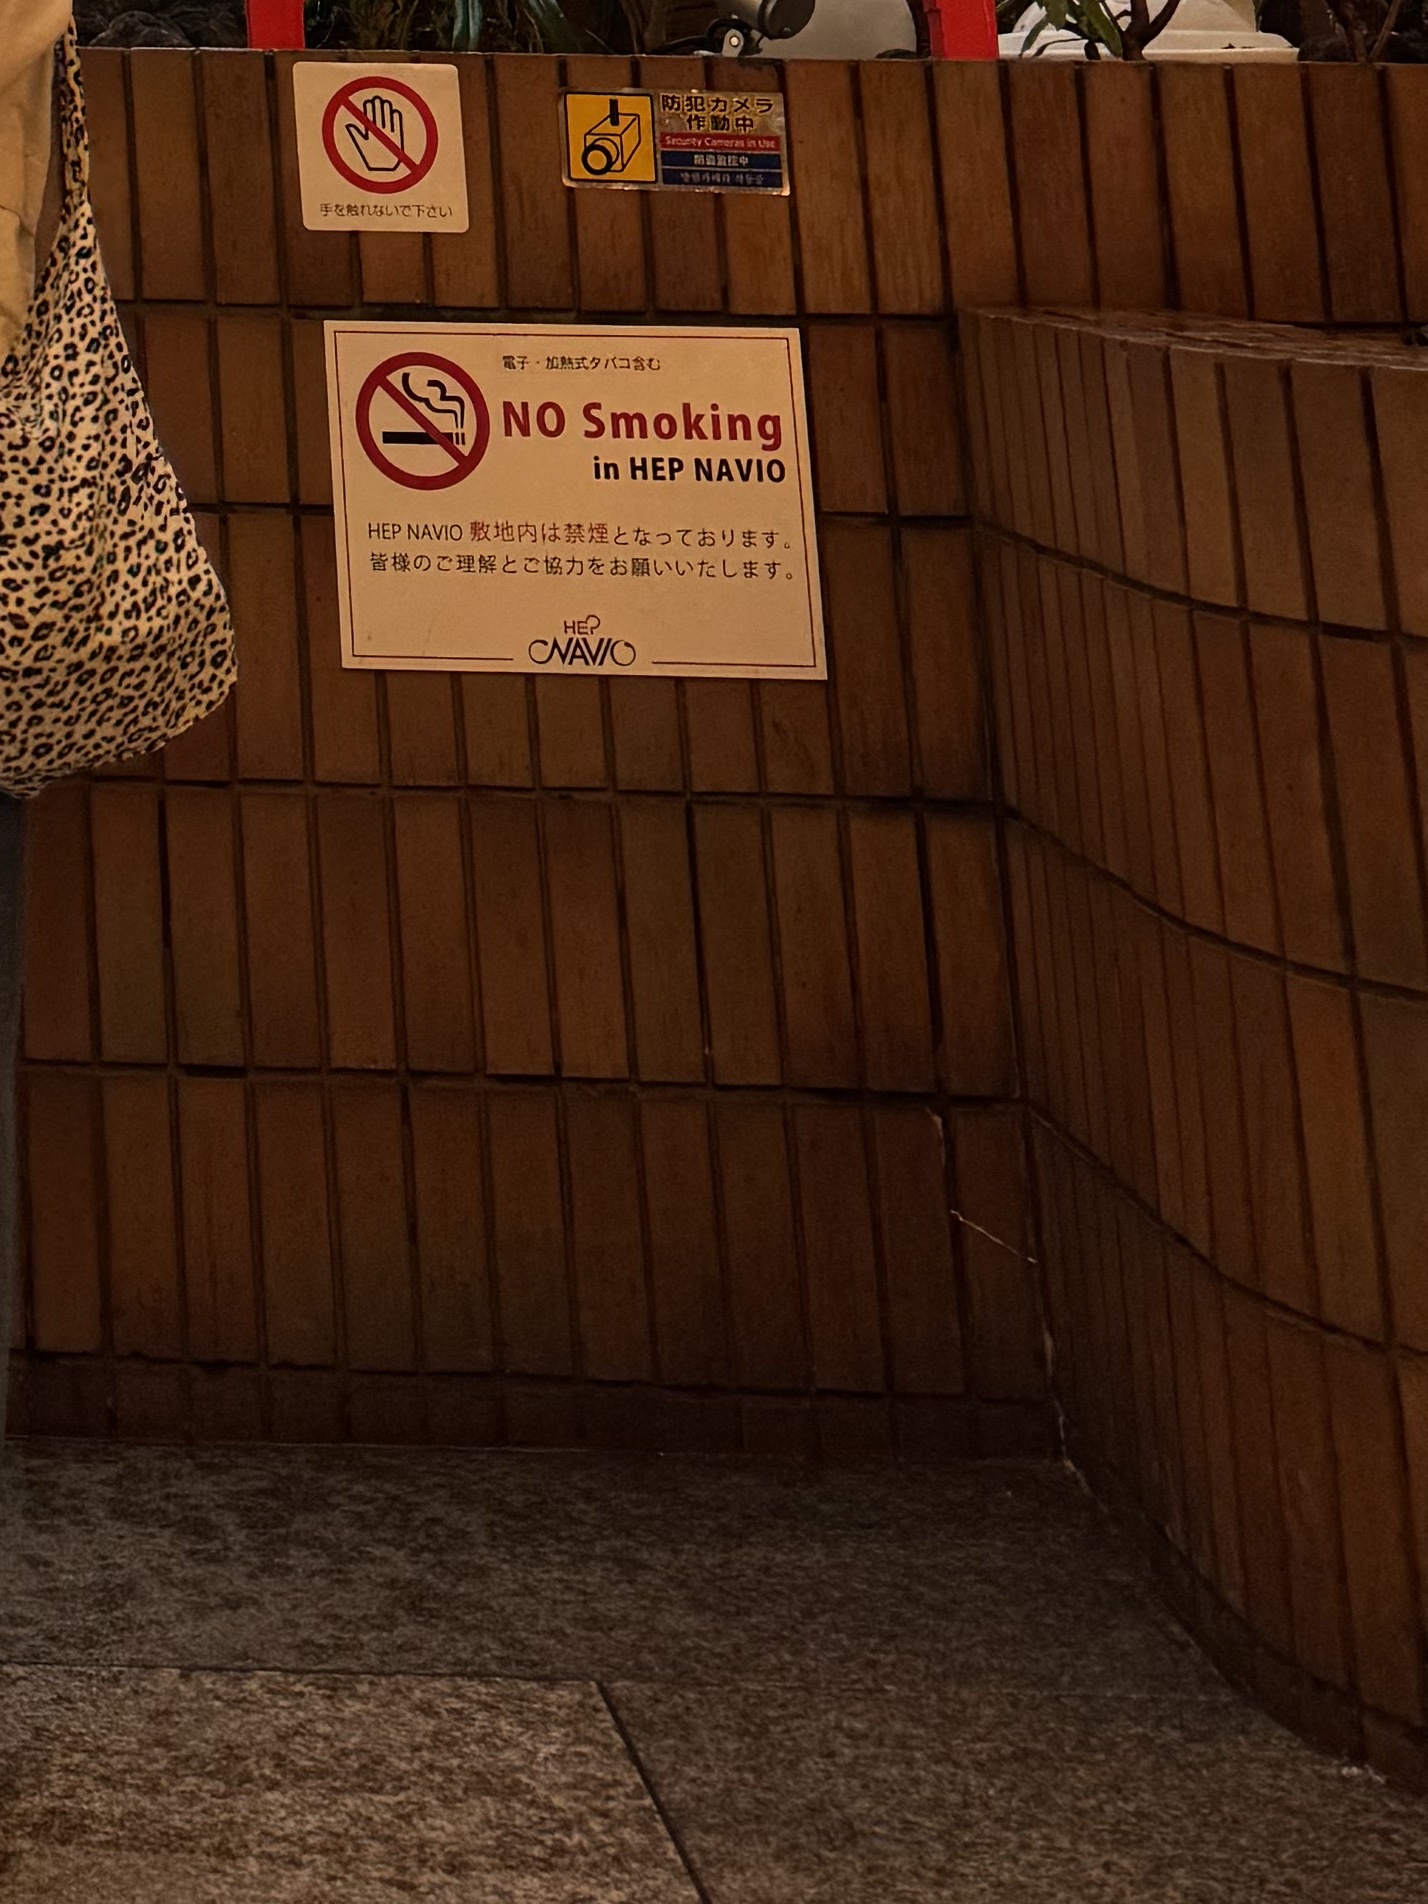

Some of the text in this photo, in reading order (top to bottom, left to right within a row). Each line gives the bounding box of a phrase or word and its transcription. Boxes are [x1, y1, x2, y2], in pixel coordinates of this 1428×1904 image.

[661, 94, 774, 113] 防犯カメラ
[686, 113, 754, 132] 作動中
[704, 137, 745, 148] Cameras
[319, 202, 453, 219] 手を触れないで下さい
[502, 400, 782, 452] NO Smoking
[593, 455, 786, 483] in HEP NAVIO
[368, 522, 401, 540] HEP
[407, 523, 463, 541] NAVIO
[370, 552, 794, 580] 皆様のご理解とご協力をお願いいたします。
[563, 614, 601, 635] HEP
[527, 637, 637, 667] NAVIO
